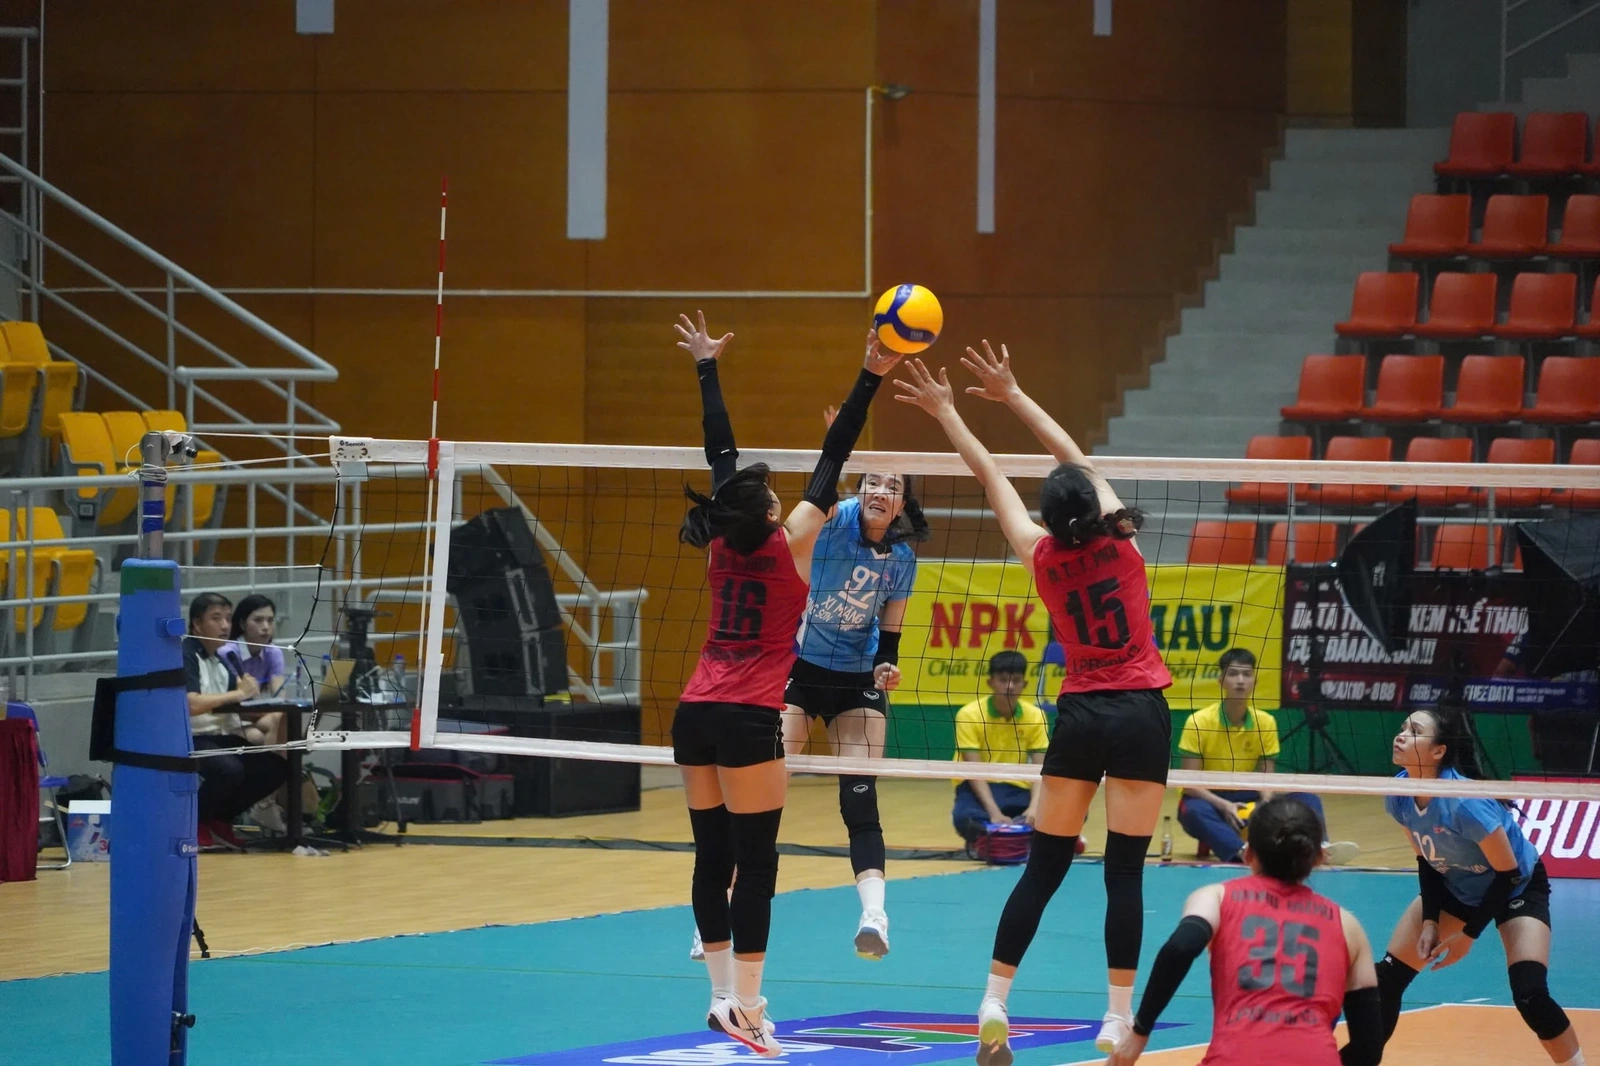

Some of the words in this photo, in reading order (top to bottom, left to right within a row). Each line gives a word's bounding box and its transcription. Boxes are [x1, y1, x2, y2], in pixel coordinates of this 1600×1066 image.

[714, 578, 767, 640] 16
[931, 602, 1035, 648] NPK
[1065, 577, 1131, 650] 15
[1413, 831, 1446, 862] 12
[1237, 914, 1320, 999] 35
